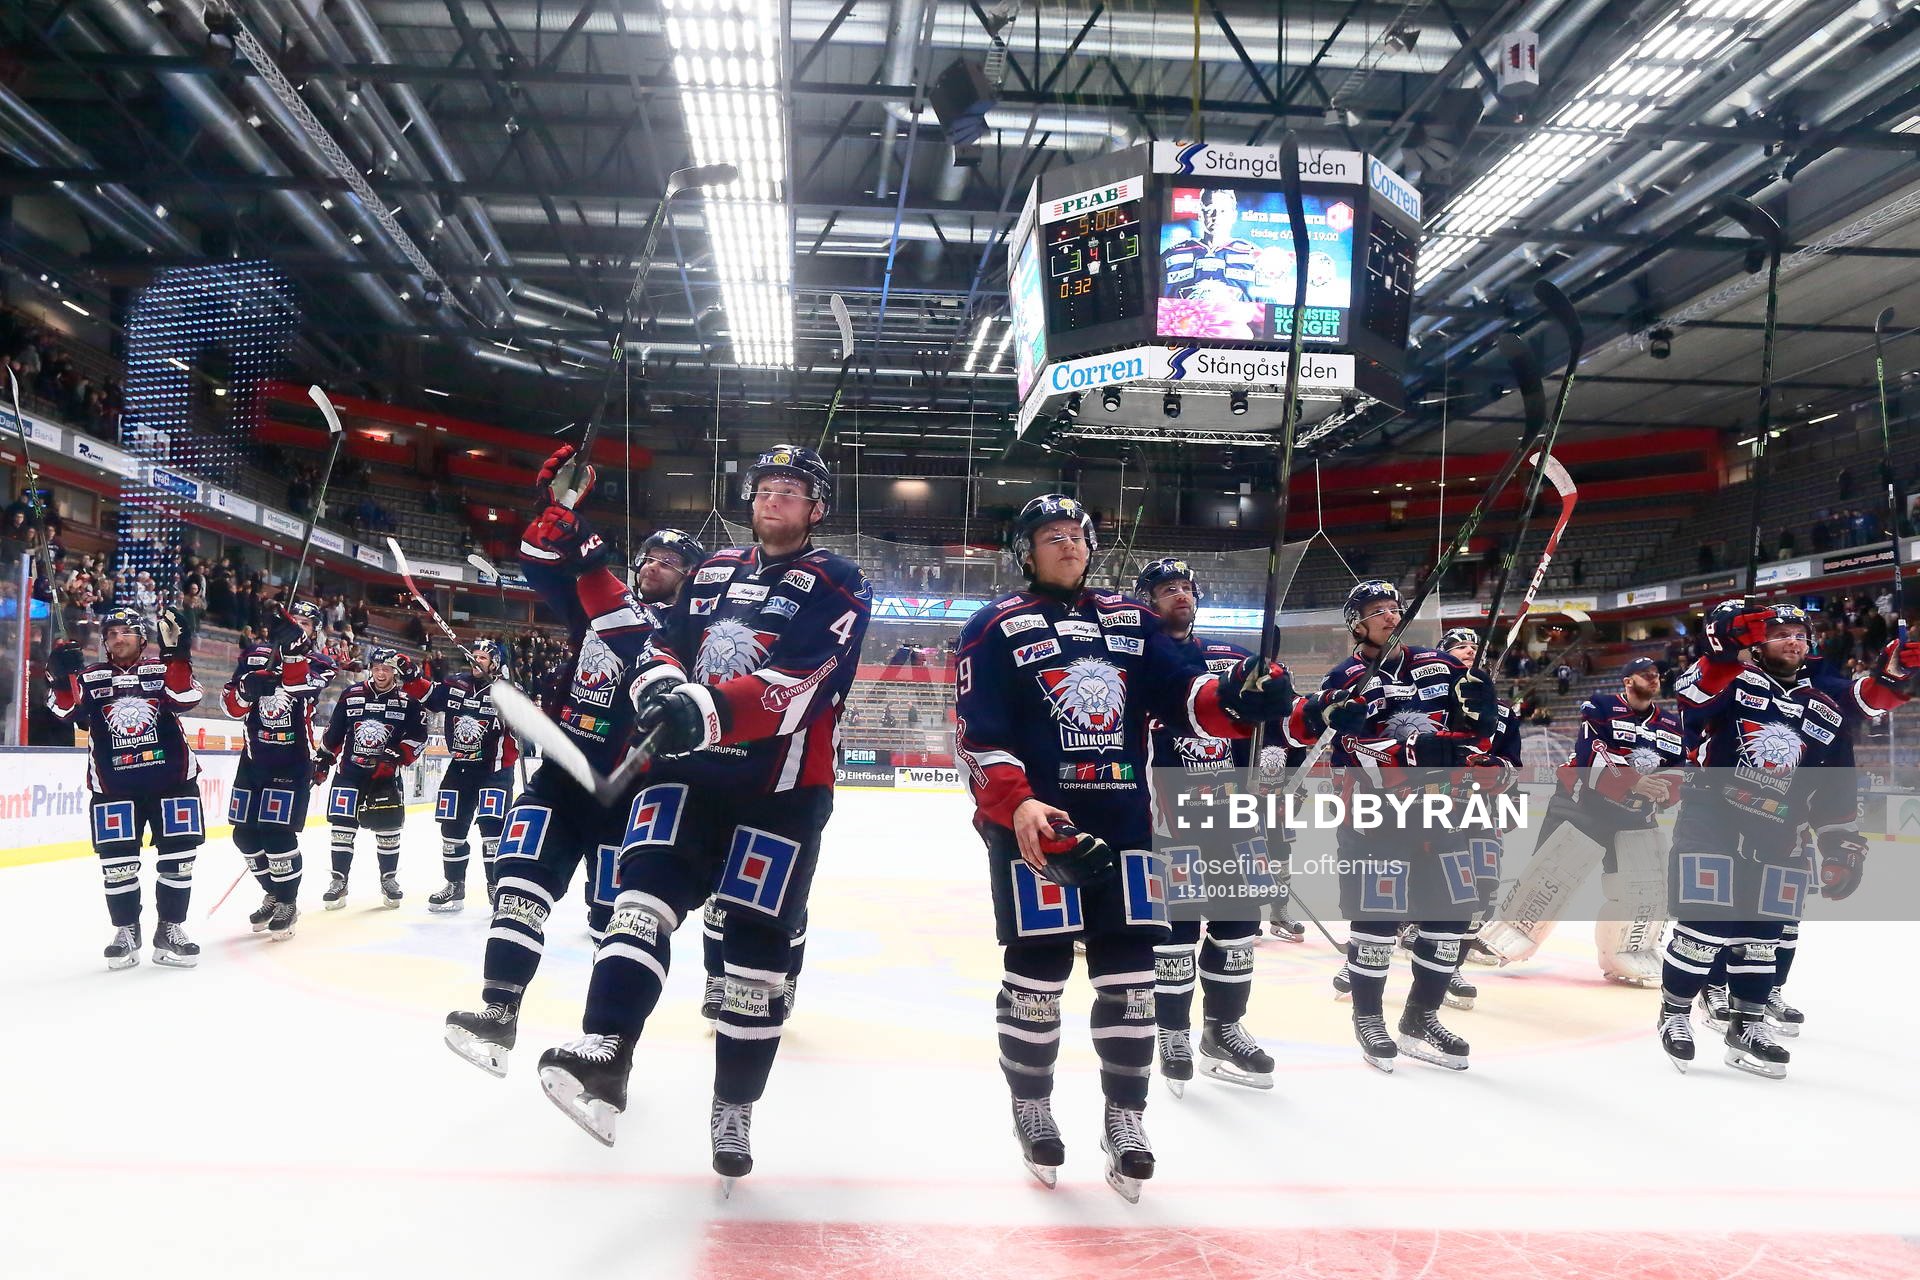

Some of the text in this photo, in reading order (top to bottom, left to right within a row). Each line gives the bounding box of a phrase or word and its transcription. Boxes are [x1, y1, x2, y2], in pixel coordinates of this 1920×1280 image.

[1205, 150, 1346, 177] Stångåaden
[1062, 187, 1119, 213] PEAB
[1369, 160, 1419, 218] Corren
[1080, 208, 1118, 235] 5:00
[1060, 277, 1092, 298] 0:32
[1052, 356, 1144, 391] Corren
[1197, 354, 1338, 381] Stångåstden
[419, 568, 441, 577] PARS
[829, 611, 857, 645] 4
[1101, 615, 1138, 626] EGENDS
[769, 660, 836, 707] TEKNIKBYGGARNA
[958, 656, 972, 696] 9
[492, 718, 501, 730] A
[1805, 721, 1831, 739] SMG
[844, 750, 876, 761] PEMA
[846, 770, 895, 781] Elitfönster
[1058, 782, 1137, 790] TORPHEIMERGRUPPEN
[1732, 800, 1785, 824] PHEIMERGRUPPEN
[503, 895, 546, 918] EWG
